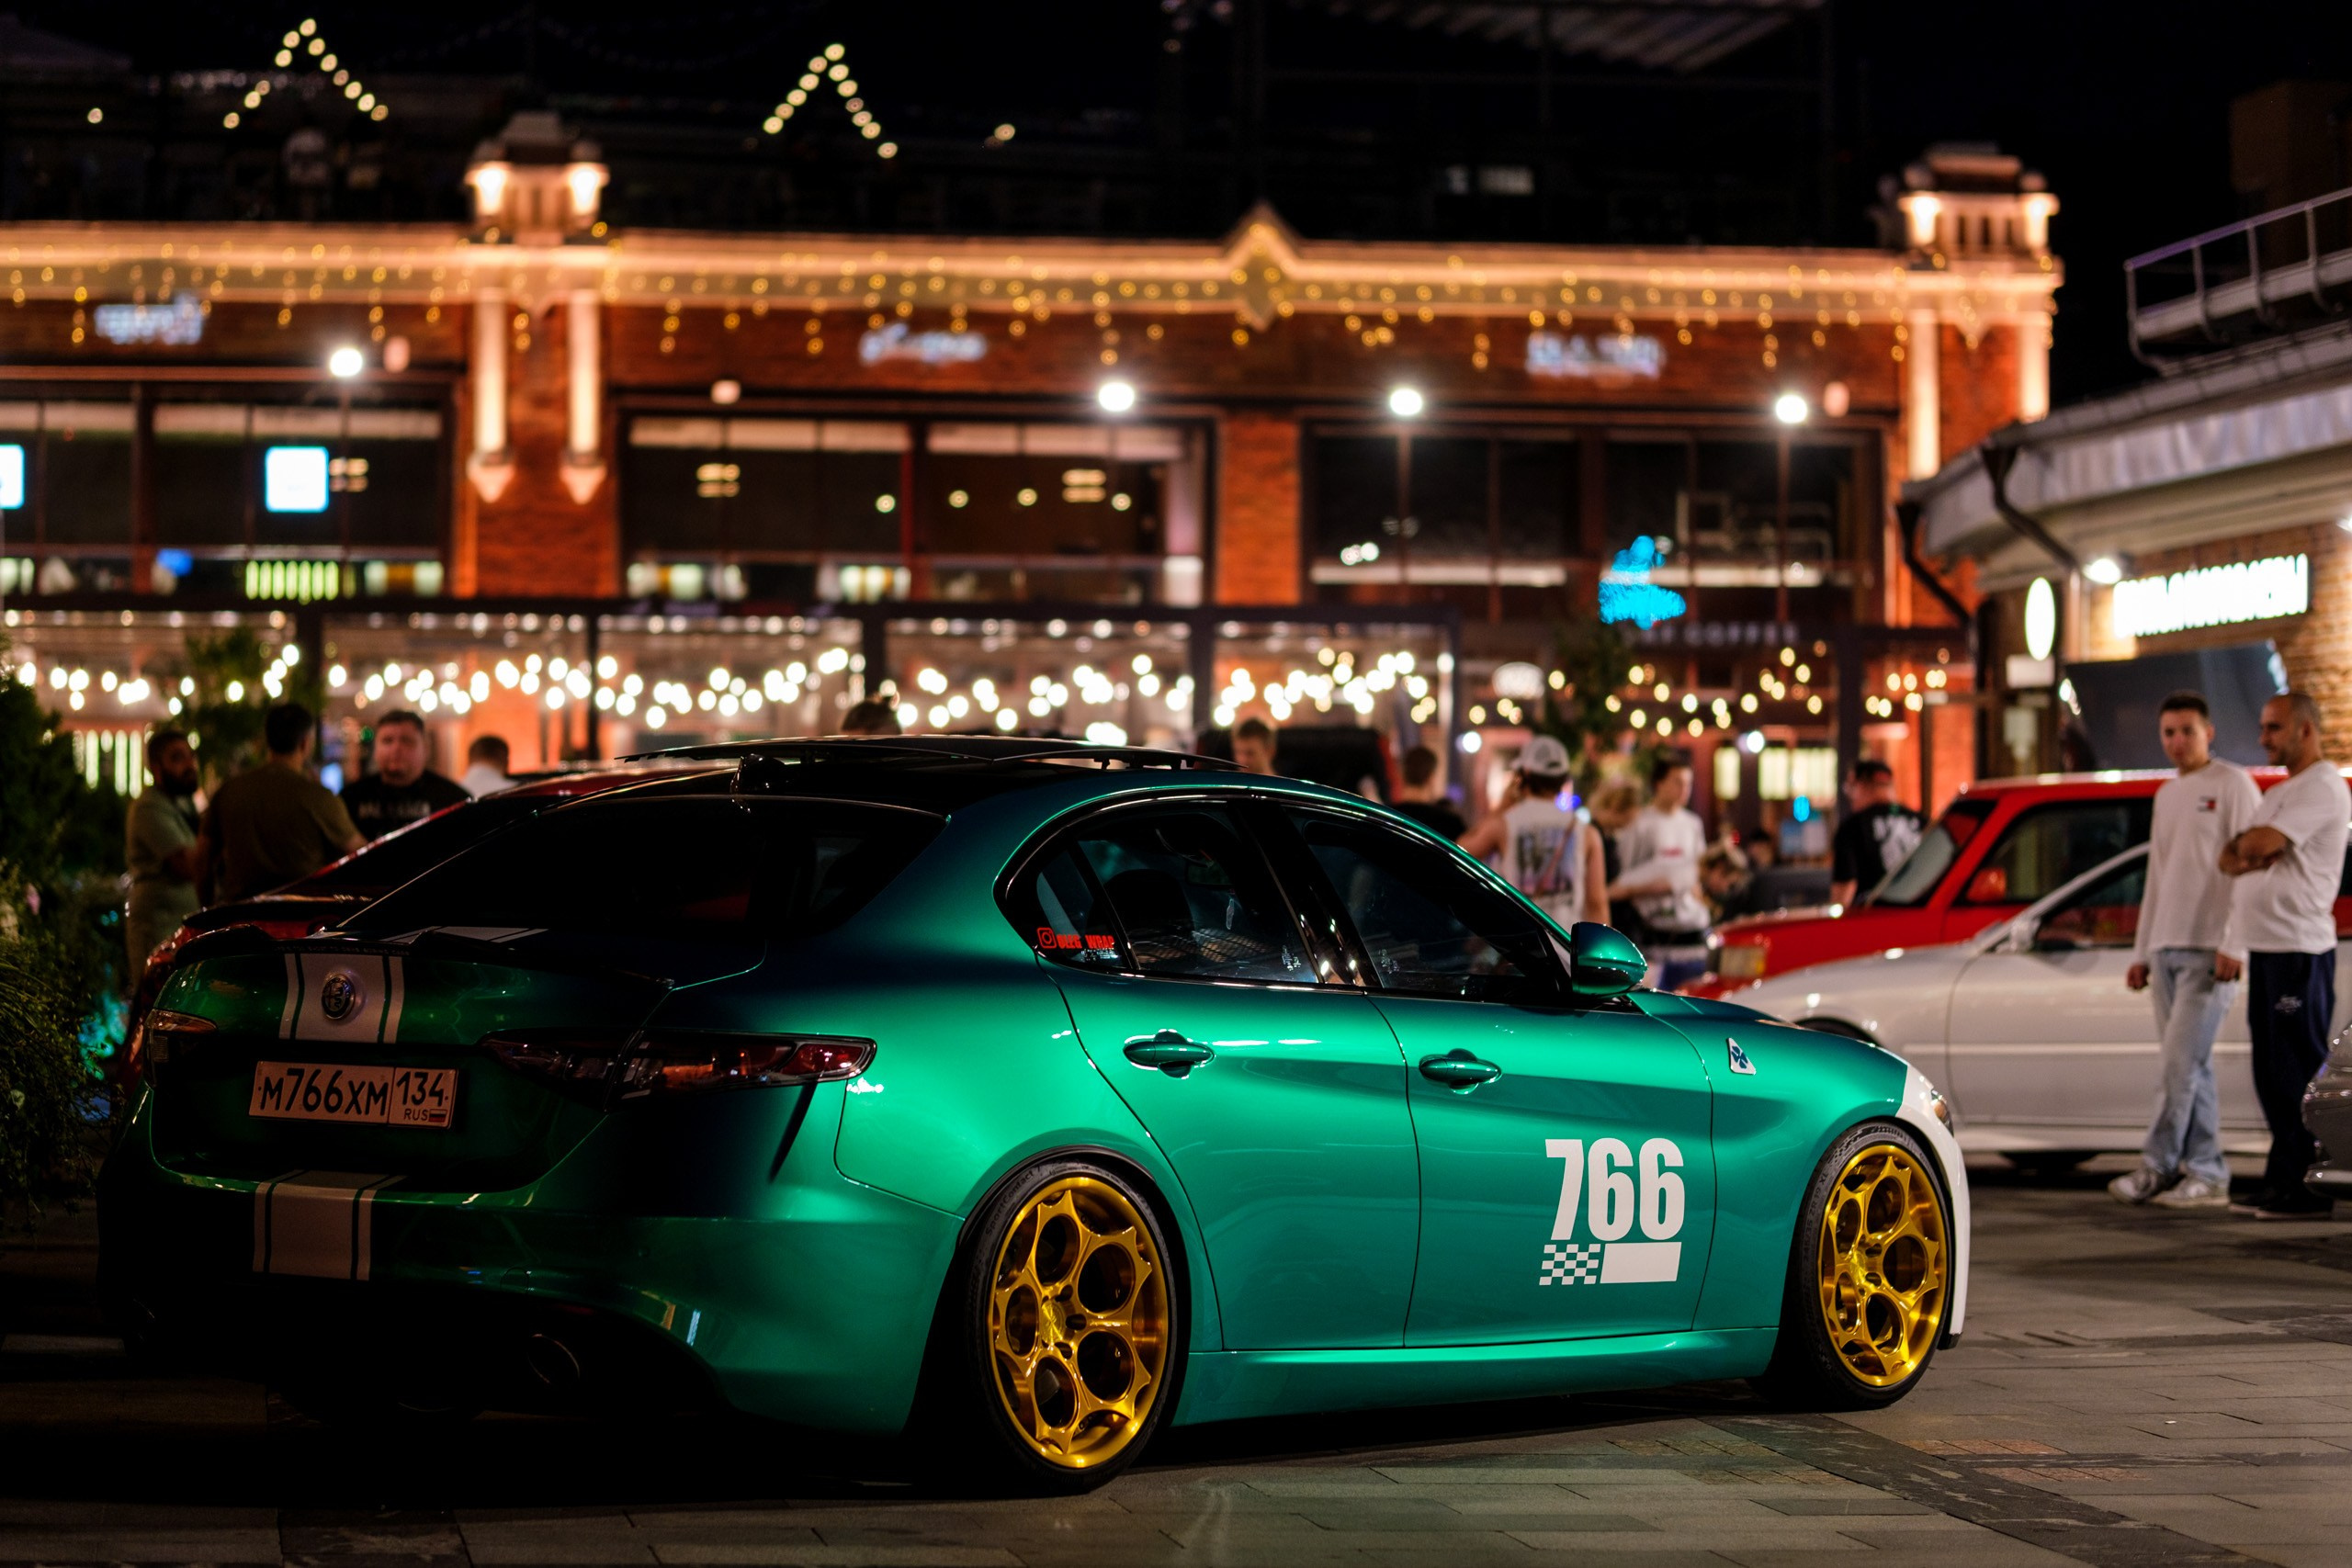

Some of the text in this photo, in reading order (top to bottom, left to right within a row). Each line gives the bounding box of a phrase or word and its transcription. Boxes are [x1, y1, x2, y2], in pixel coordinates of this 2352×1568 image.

[1084, 934, 1115, 949] WRAP
[396, 1070, 445, 1107] 134
[403, 1108, 429, 1121] RUS
[985, 1169, 1035, 1236] SportContact
[1544, 1137, 1685, 1241] 766
